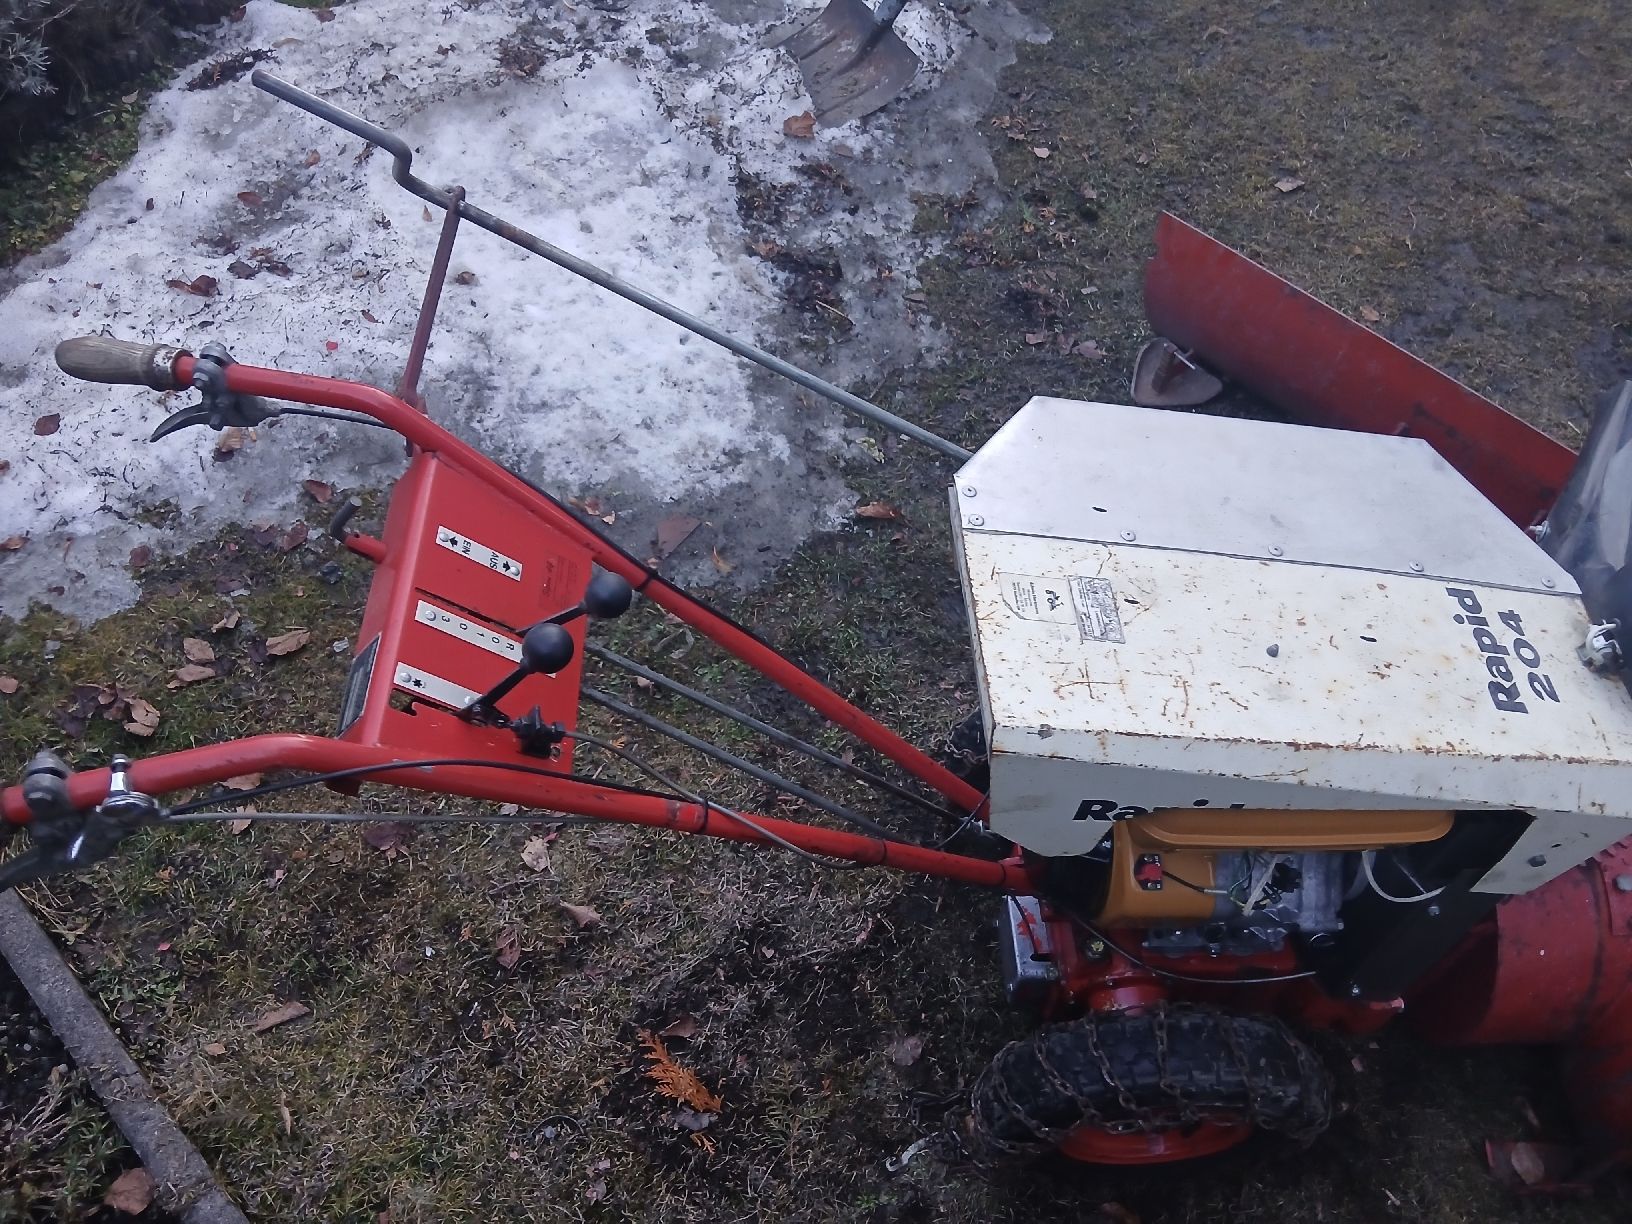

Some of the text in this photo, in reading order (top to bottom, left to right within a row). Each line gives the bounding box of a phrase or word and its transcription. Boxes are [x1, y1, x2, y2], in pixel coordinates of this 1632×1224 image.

[462, 540, 471, 555] EIN
[490, 551, 499, 570] AUS
[442, 615, 450, 623] 3
[506, 642, 515, 651] R
[1445, 587, 1529, 714] Rapid
[1498, 610, 1560, 702] 204
